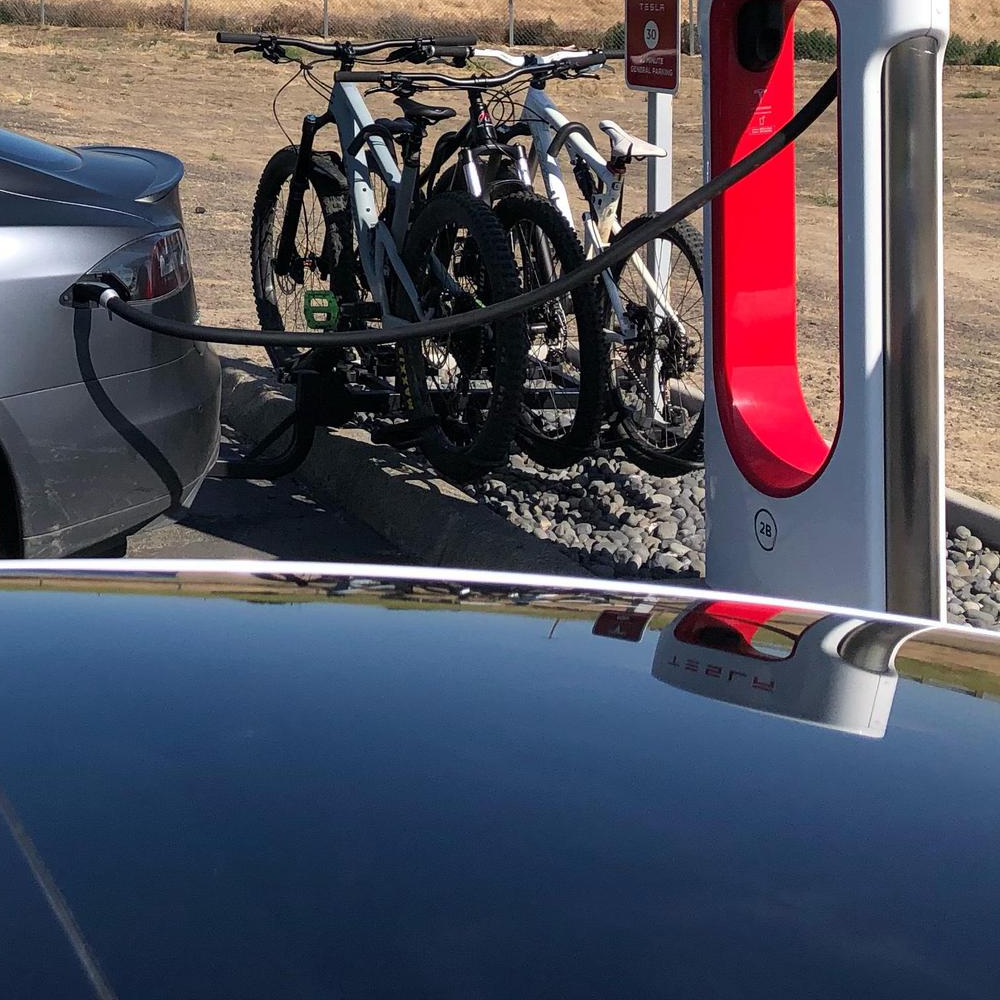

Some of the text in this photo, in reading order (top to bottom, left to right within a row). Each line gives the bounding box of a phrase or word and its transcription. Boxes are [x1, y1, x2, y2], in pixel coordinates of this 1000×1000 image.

[639, 2, 665, 12] TESLA
[646, 28, 657, 40] 30
[630, 65, 652, 74] GENERAL
[760, 521, 771, 537] 2B
